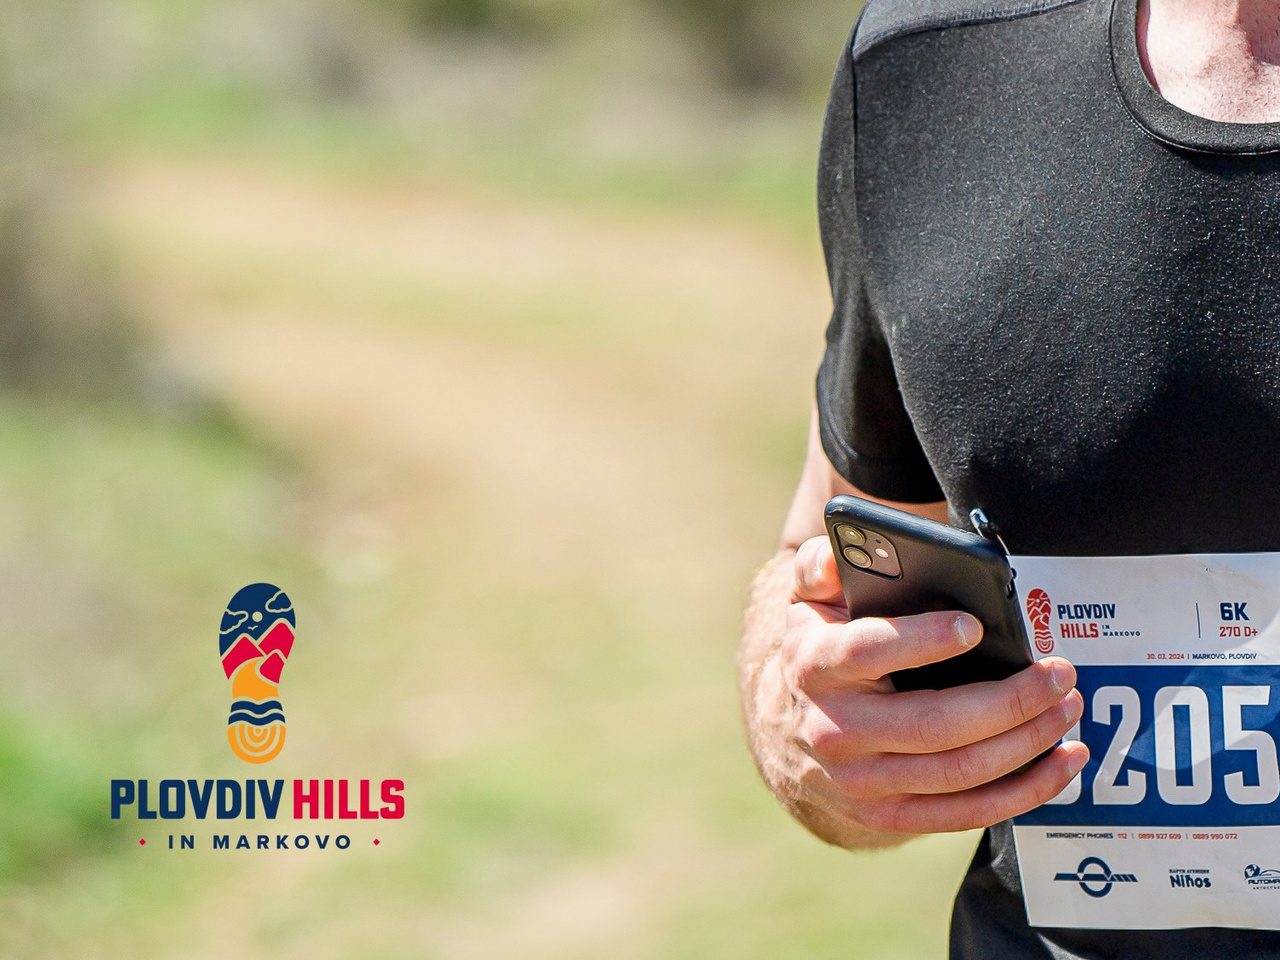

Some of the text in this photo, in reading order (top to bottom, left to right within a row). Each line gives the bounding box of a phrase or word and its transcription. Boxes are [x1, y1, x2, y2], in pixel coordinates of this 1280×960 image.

[1057, 603, 1117, 620] PLOVDIV
[1219, 602, 1250, 621] 6K
[1060, 622, 1099, 639] HILLS
[1219, 626, 1258, 638] 270 D+
